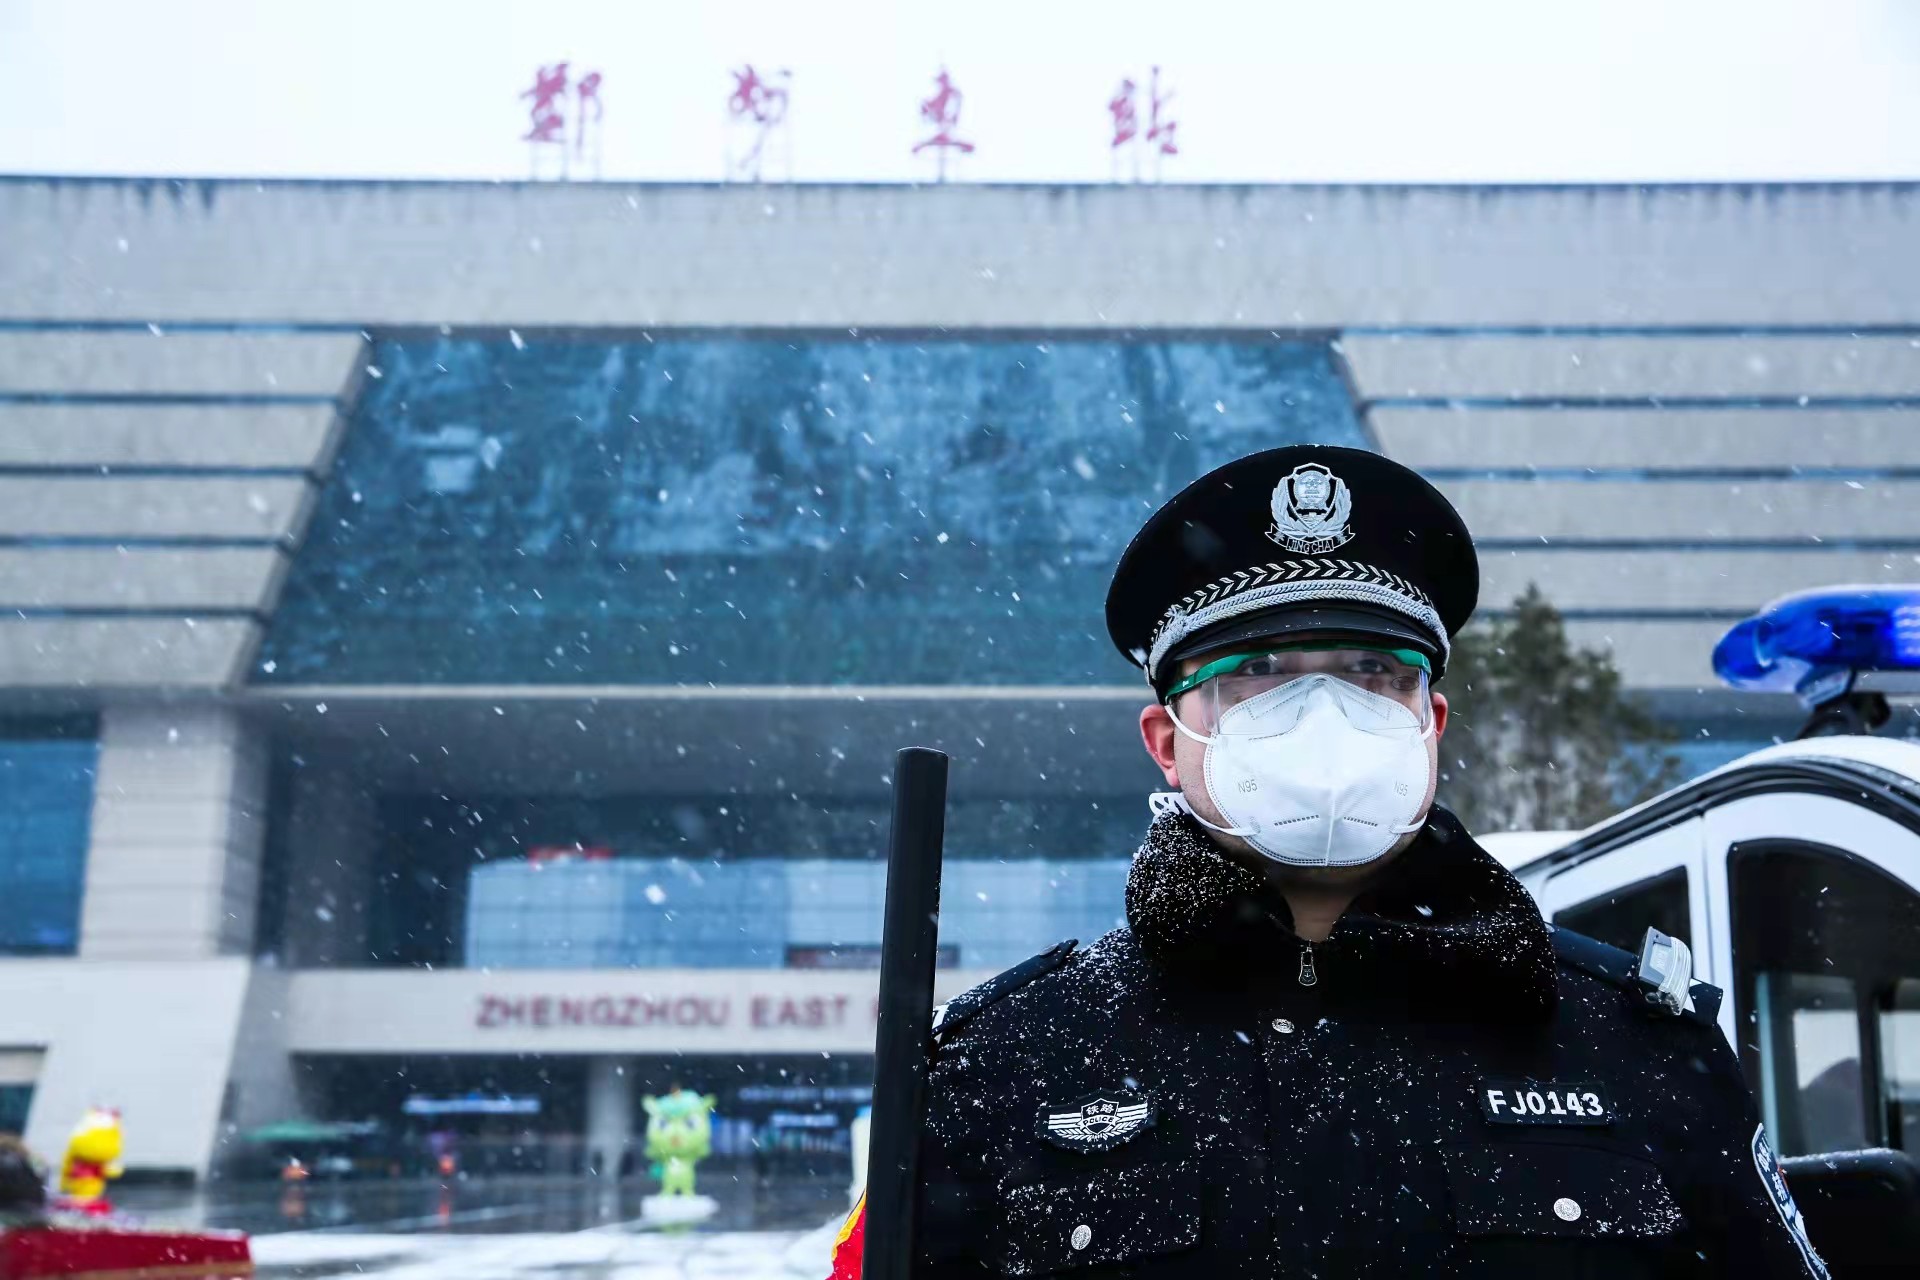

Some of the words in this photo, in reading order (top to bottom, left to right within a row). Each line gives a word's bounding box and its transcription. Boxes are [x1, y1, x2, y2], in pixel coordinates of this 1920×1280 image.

[1237, 778, 1258, 794] N95
[1393, 780, 1409, 797] N95
[476, 993, 729, 1028] ZHENGZHOU
[749, 992, 849, 1027] EAST
[1086, 1103, 1114, 1115] 铁路
[1083, 1116, 1115, 1126] POLICE
